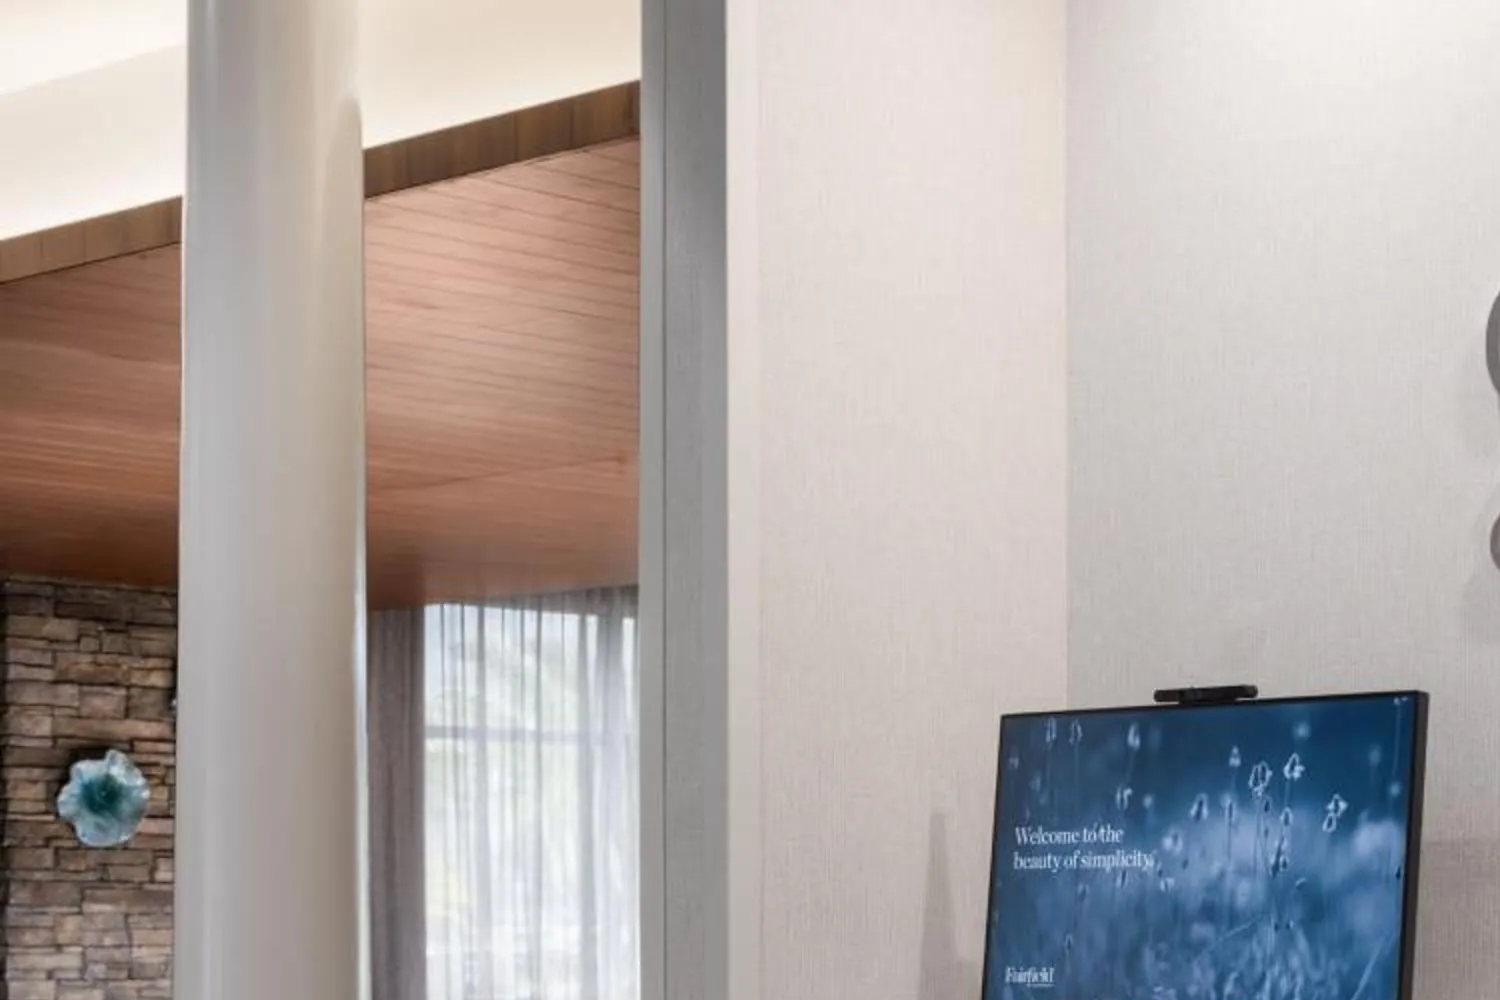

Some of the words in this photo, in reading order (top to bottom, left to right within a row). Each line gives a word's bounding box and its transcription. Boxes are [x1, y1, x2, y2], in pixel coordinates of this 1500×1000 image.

[1015, 825, 1080, 846] Welcome
[1083, 827, 1097, 843] to
[1099, 824, 1124, 843] the
[1013, 851, 1061, 873] beauty
[1063, 850, 1081, 869] of
